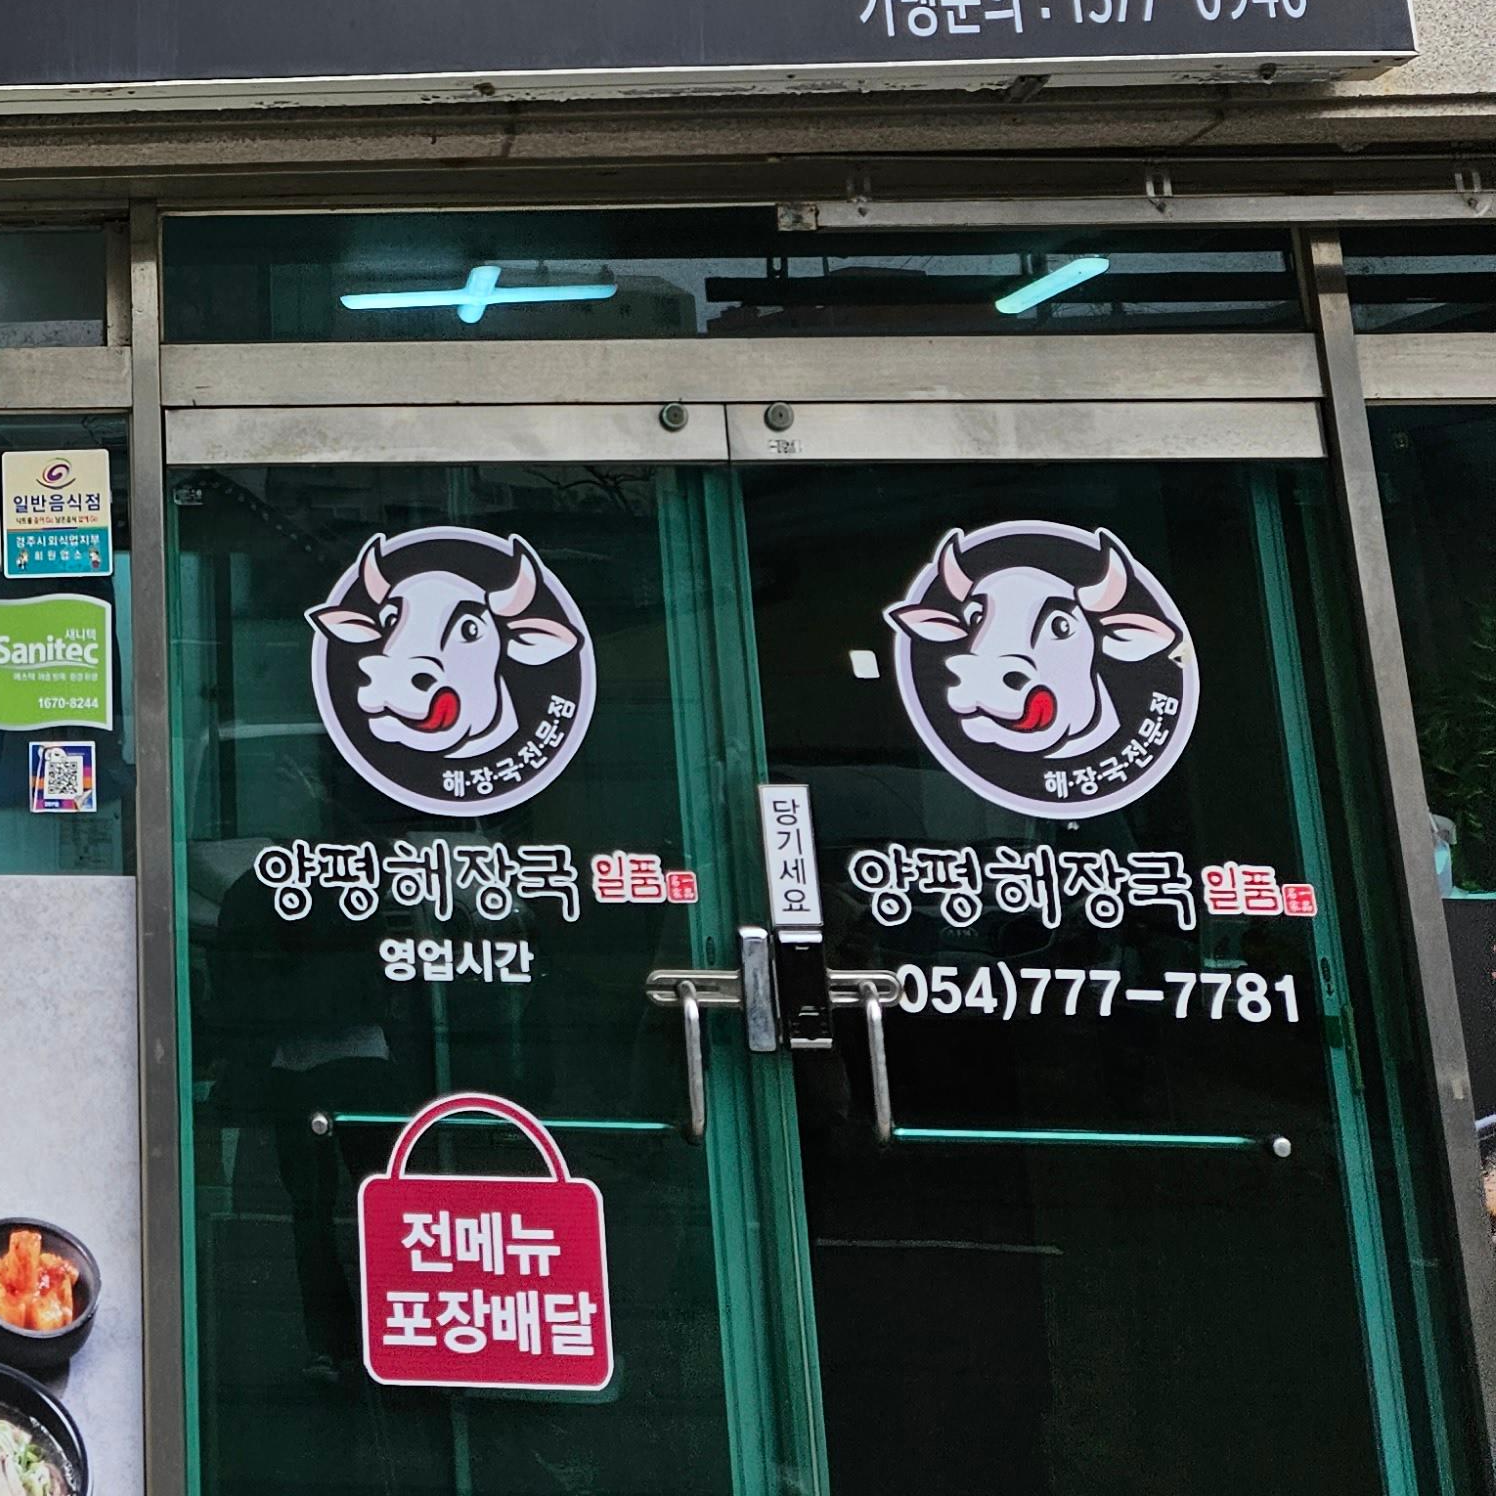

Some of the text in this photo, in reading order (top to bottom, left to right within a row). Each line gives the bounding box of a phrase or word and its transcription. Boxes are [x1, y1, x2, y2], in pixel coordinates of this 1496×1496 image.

[13, 492, 101, 514] 일반음식점
[38, 696, 99, 709] 1670-8244
[254, 839, 666, 922] 양평해장국 일품
[772, 798, 811, 913] 당기세요
[848, 843, 1282, 931] 양평해장국 일품
[379, 939, 534, 983] 영업시간
[898, 963, 1299, 1023] 054)777-7781
[401, 1210, 561, 1277] 전메뉴
[383, 1289, 597, 1356] 포장배달
